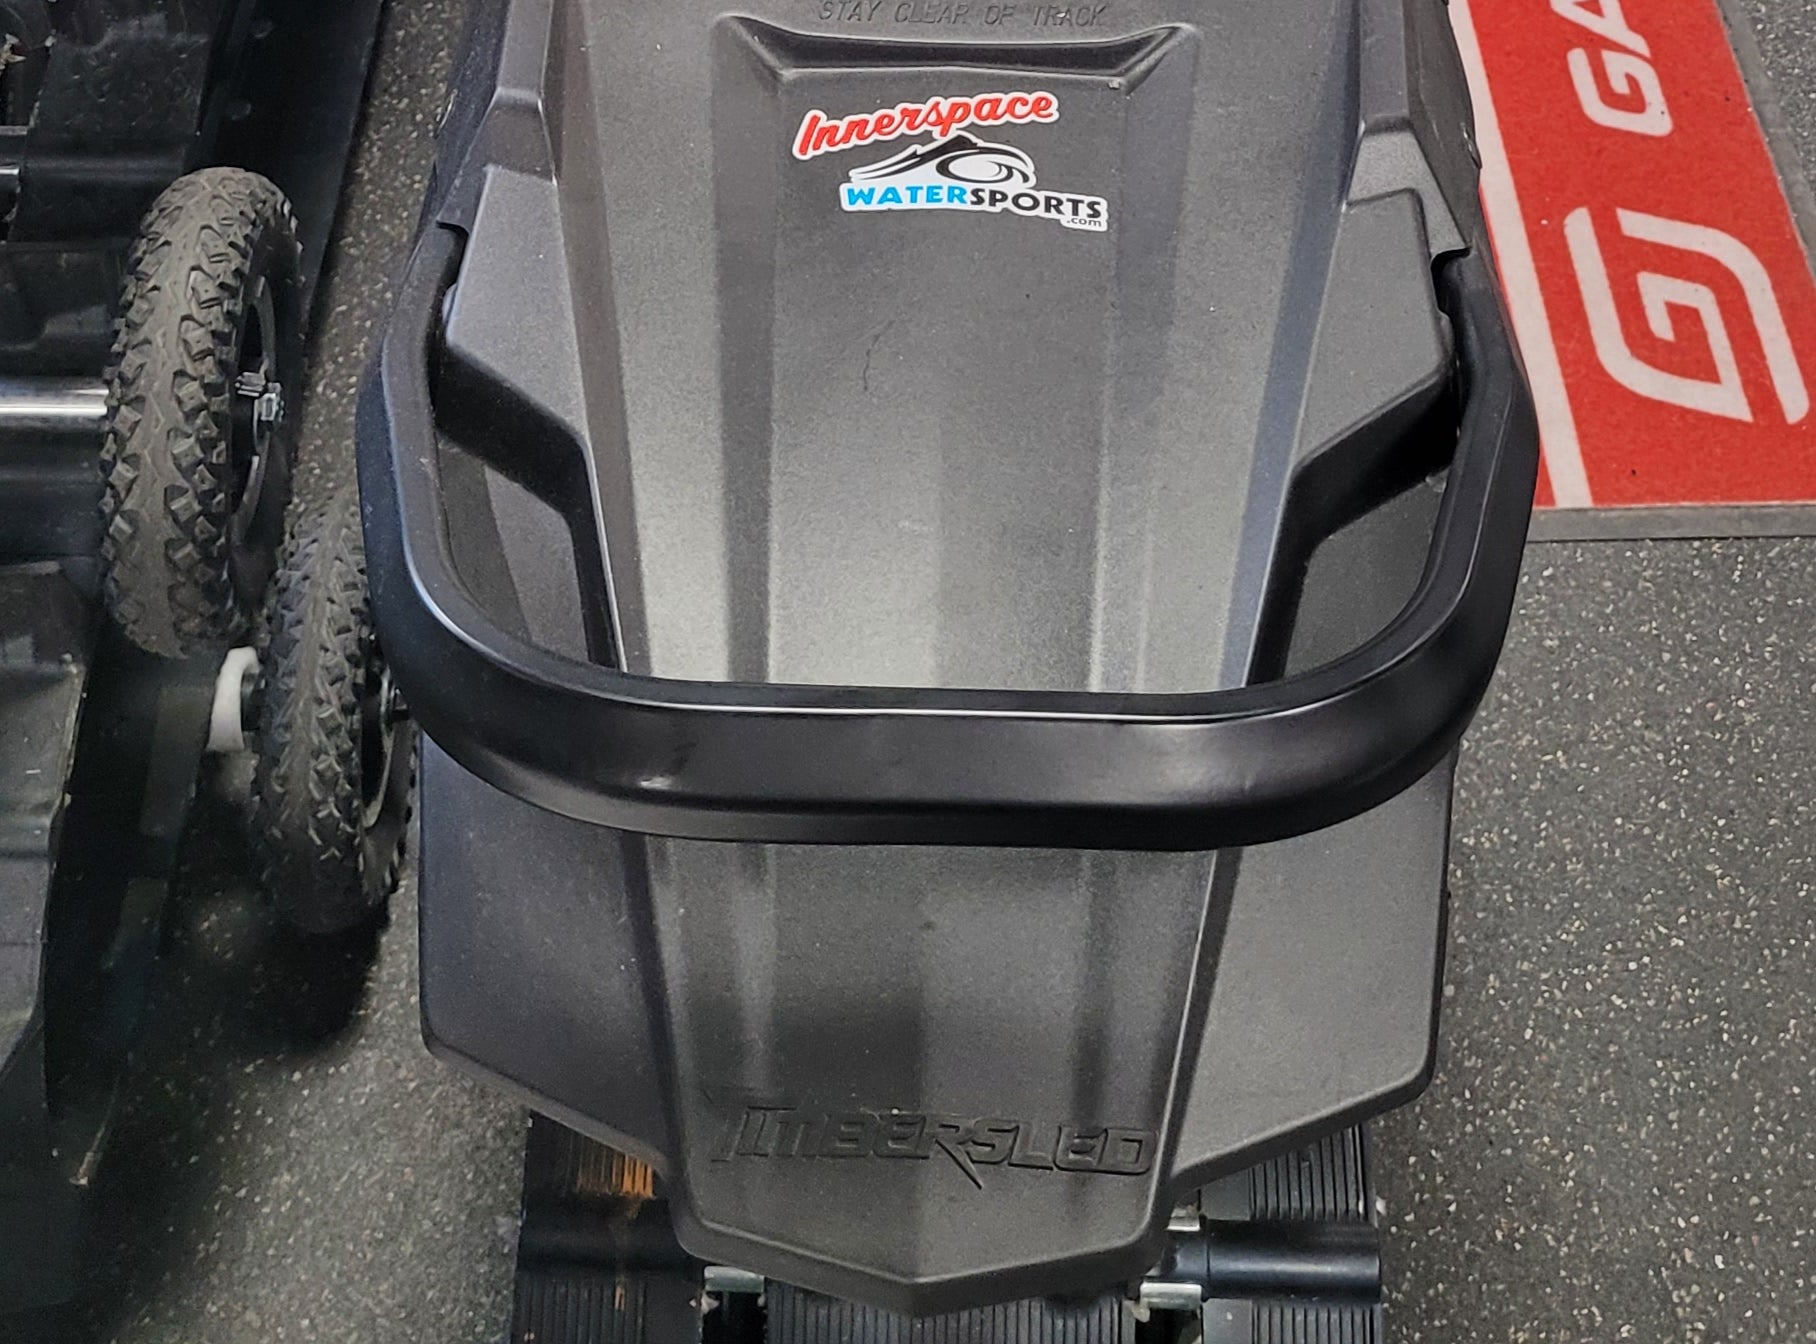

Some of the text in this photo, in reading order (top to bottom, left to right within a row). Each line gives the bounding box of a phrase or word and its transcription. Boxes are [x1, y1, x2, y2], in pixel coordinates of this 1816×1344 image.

[819, 0, 1107, 28] STAY CLEAR OF TRACK
[799, 95, 1053, 157] Innerspace
[846, 184, 1102, 219] WATERSPORTS
[1066, 214, 1102, 228] .com
[705, 1097, 1156, 1190] TIMBERSLED
